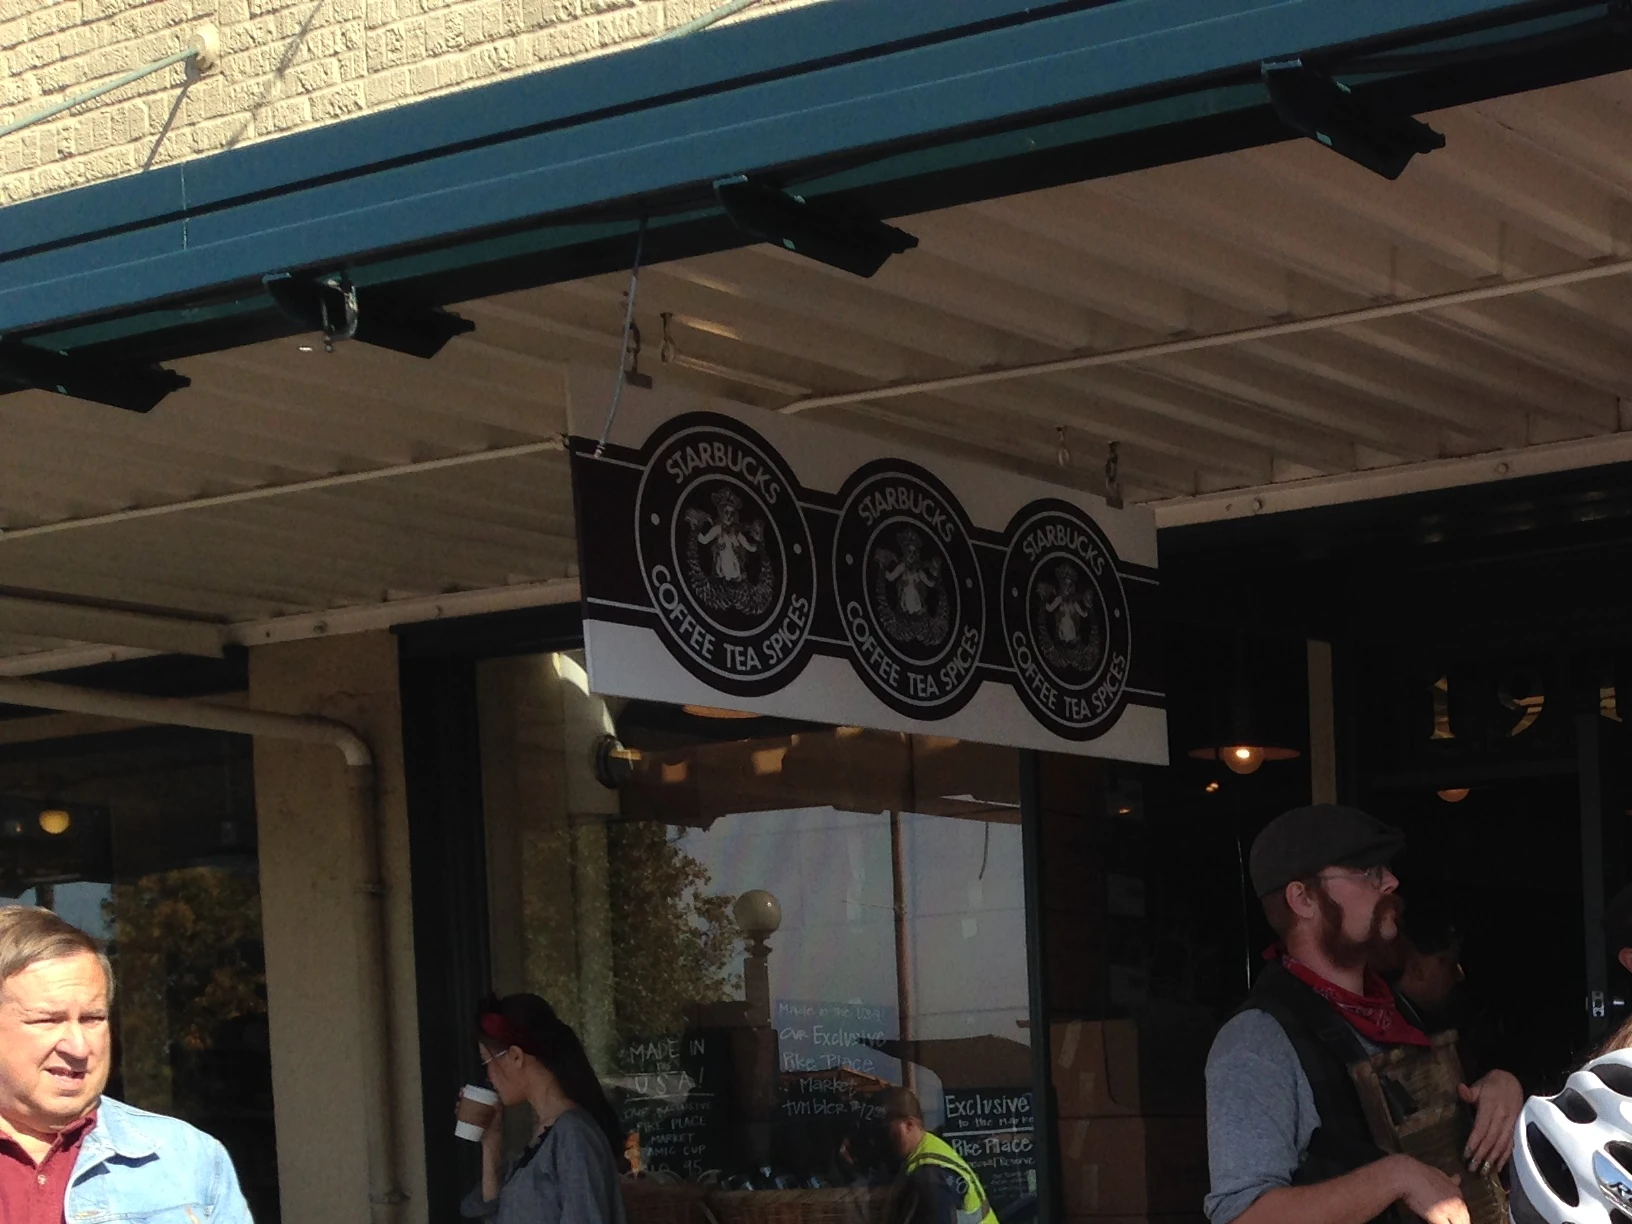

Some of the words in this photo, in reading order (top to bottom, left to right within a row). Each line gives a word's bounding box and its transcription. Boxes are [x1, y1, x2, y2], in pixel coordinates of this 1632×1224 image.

[665, 442, 780, 504] STARBUCKS
[857, 486, 956, 543] STARBUCKS
[1022, 524, 1106, 577] STARBUCKS
[651, 563, 716, 659] COFFEE
[723, 643, 762, 671] TEA
[761, 593, 809, 669] SPICES
[846, 601, 901, 688] COFFEE
[907, 671, 939, 698] TEA
[940, 624, 978, 694] SPICES
[1012, 630, 1057, 710] COFFEE
[1064, 697, 1092, 720] TEA
[1091, 651, 1127, 714] SPICES
[813, 1024, 888, 1048] Exclusive
[629, 1037, 680, 1064] MADE
[689, 1038, 705, 1056] IN
[783, 1051, 818, 1072] Pike
[820, 1051, 876, 1073] Place
[800, 1076, 858, 1099] Market
[945, 1093, 1031, 1118] Exclusive
[671, 1115, 707, 1131] PLACE
[957, 1119, 970, 1129] to
[651, 1132, 695, 1145] MARKET
[683, 1144, 707, 1157] CUP
[951, 1138, 983, 1157] Pike
[984, 1138, 1034, 1155] Place
